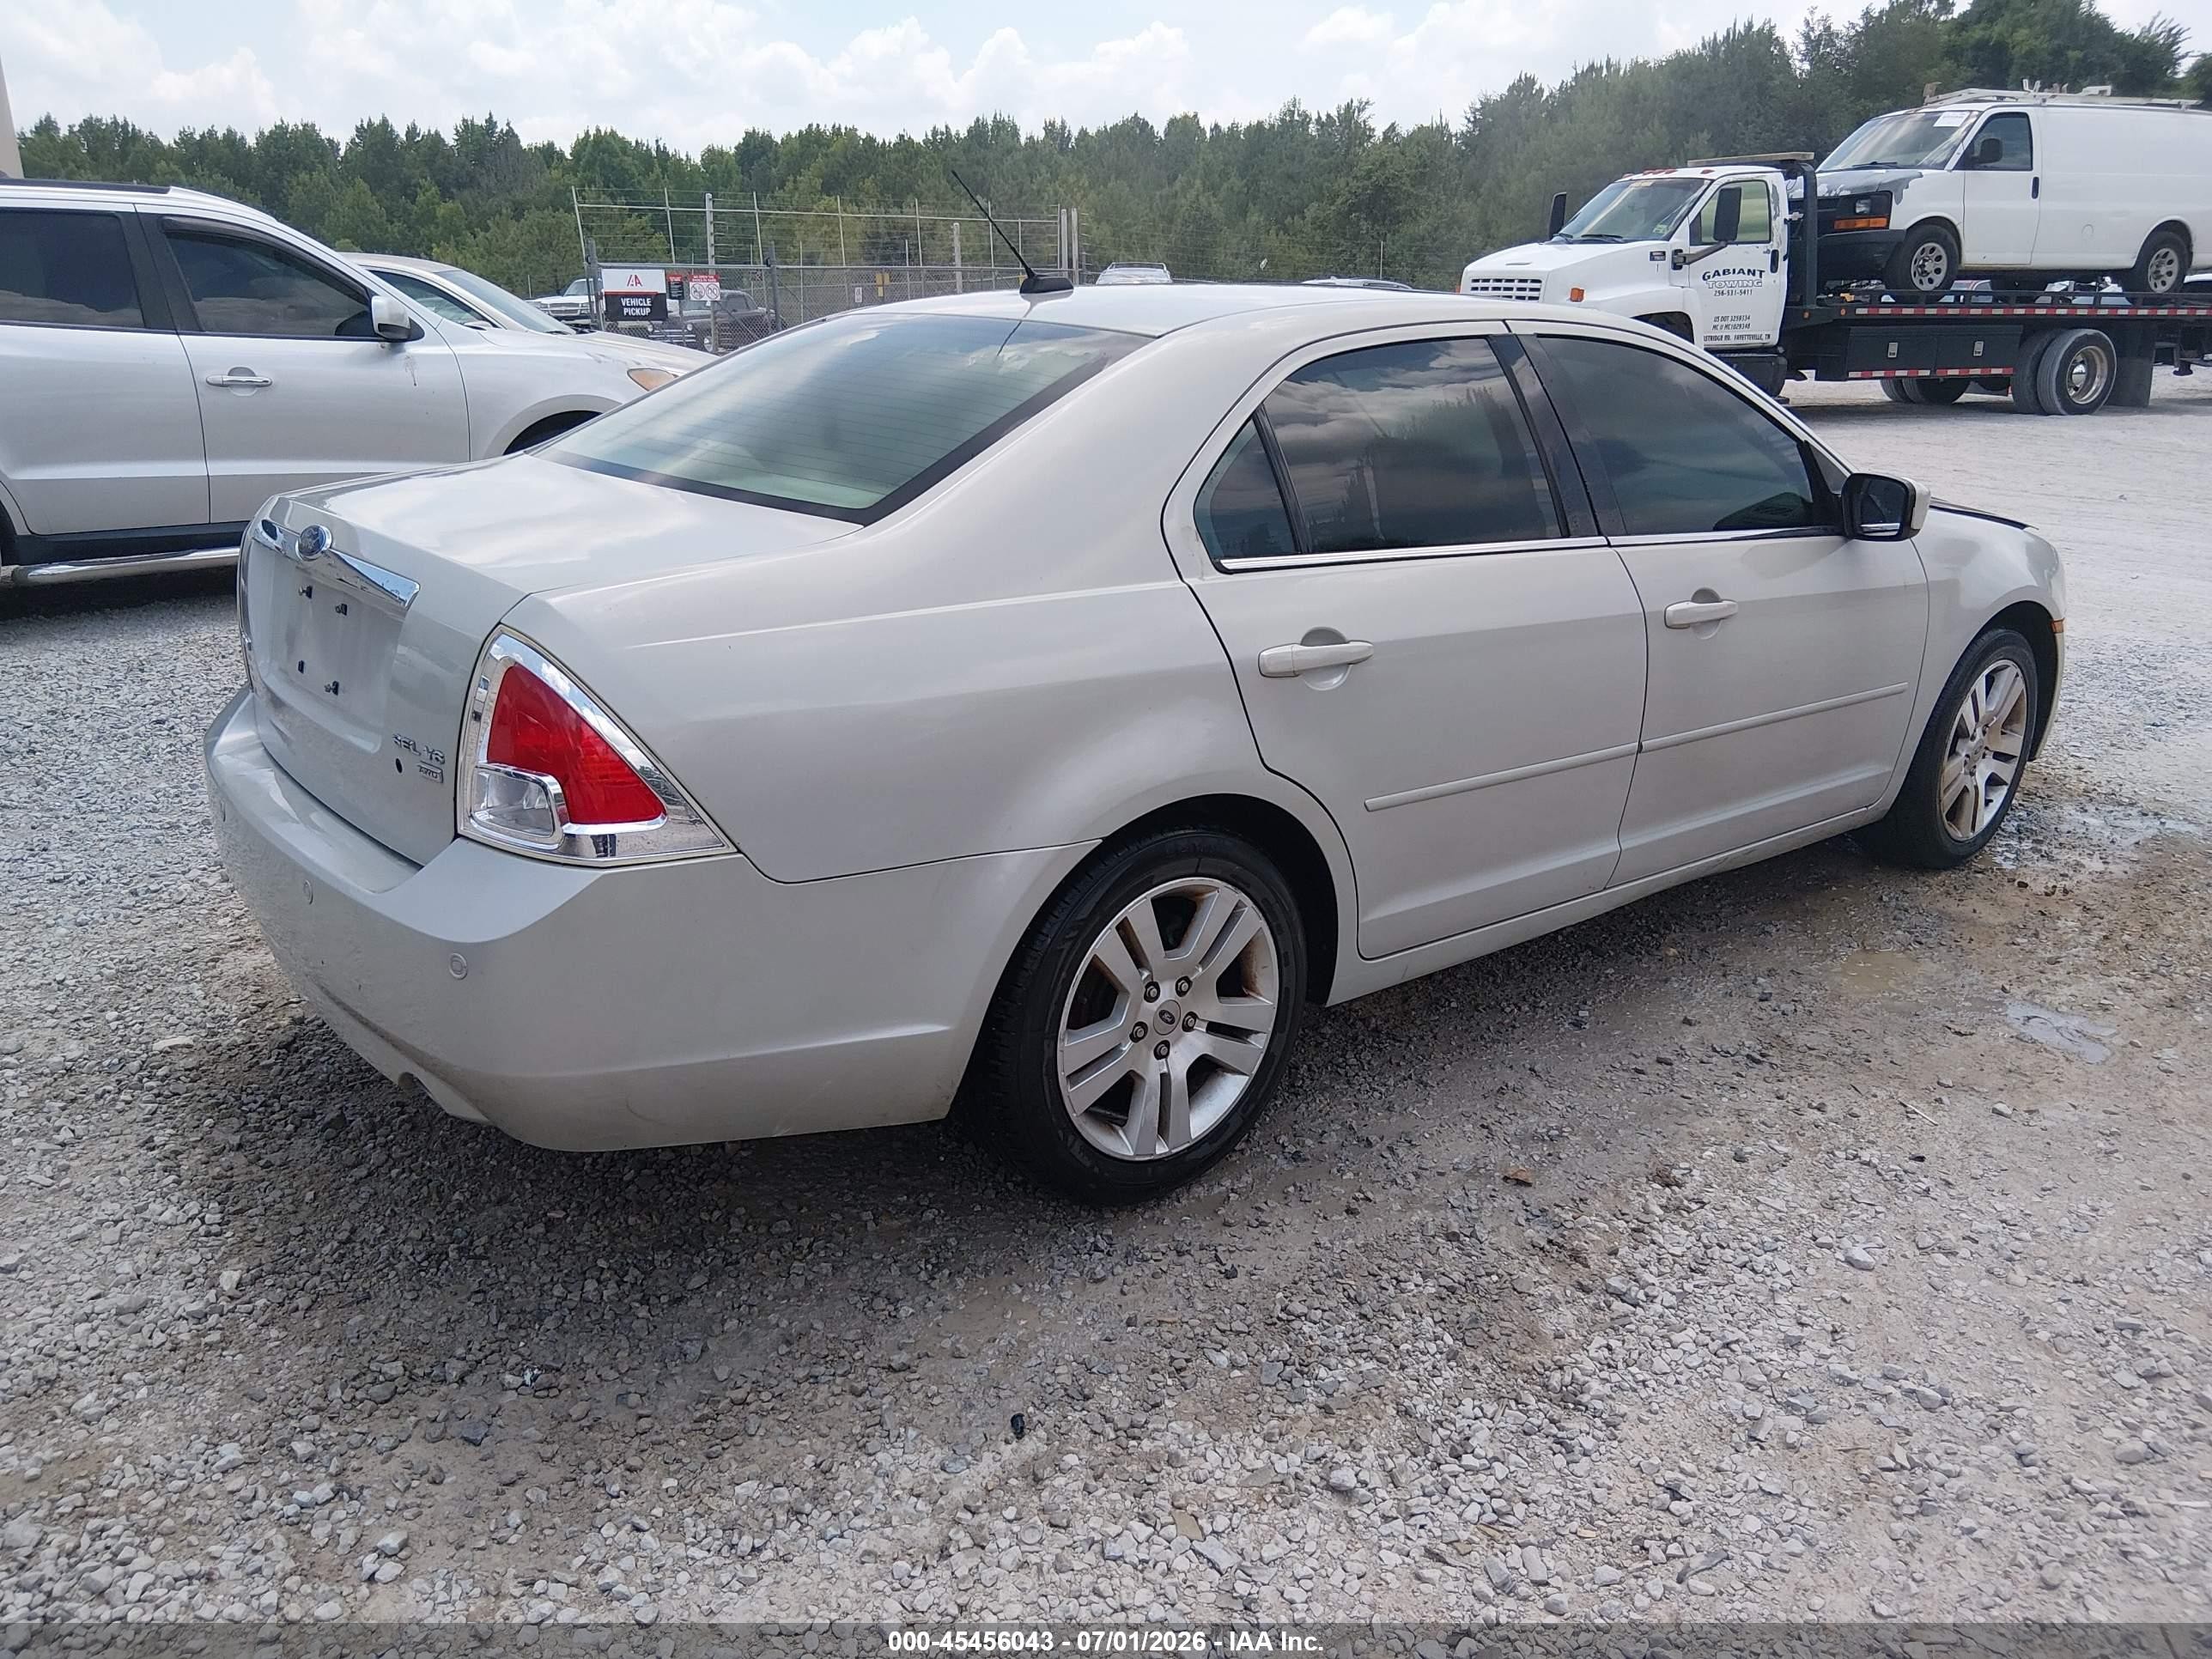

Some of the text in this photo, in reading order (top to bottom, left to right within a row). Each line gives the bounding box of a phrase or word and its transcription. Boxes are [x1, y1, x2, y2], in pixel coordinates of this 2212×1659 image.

[1702, 268, 1765, 281] GABIANT
[1706, 279, 1763, 289] TOWING
[621, 297, 652, 307] VEHICLE
[623, 307, 651, 316] PICKUP
[392, 733, 422, 757] SEL
